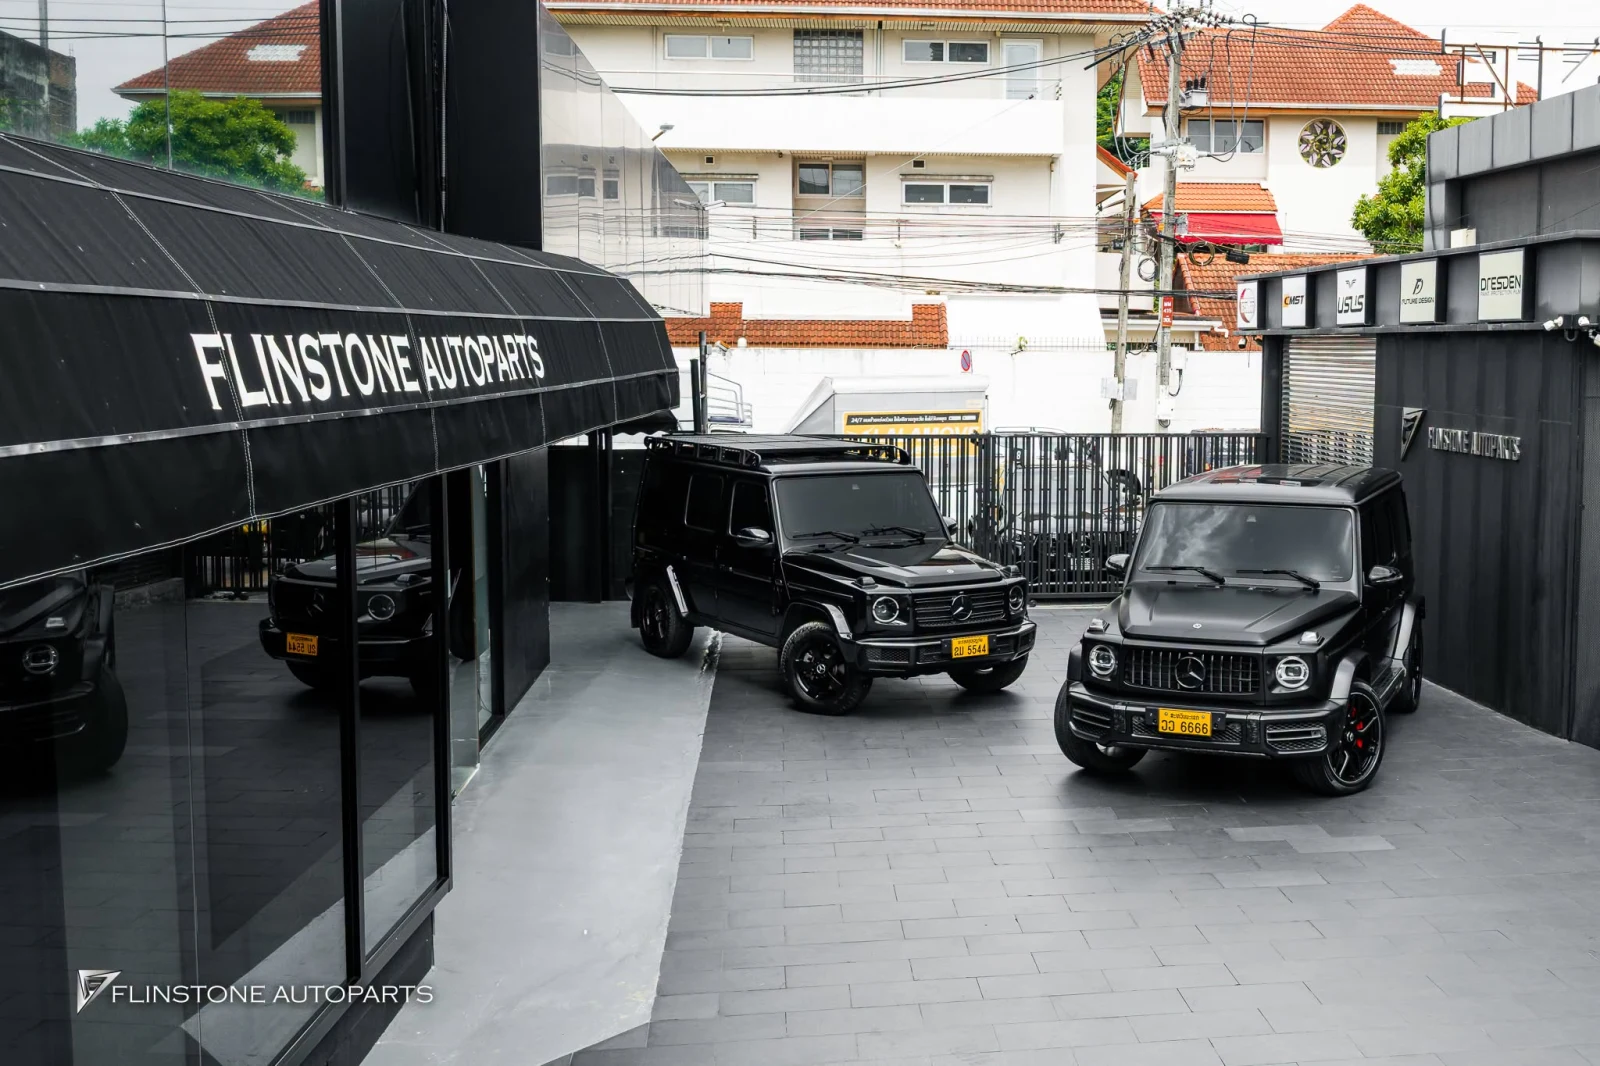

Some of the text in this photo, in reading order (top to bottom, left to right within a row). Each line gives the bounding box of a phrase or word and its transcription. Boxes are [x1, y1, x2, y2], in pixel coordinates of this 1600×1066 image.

[1284, 295, 1304, 306] CMST
[190, 332, 545, 410] FLINSTONE AUTOPARTS
[968, 644, 986, 654] 5544
[1180, 721, 1208, 734] 6666
